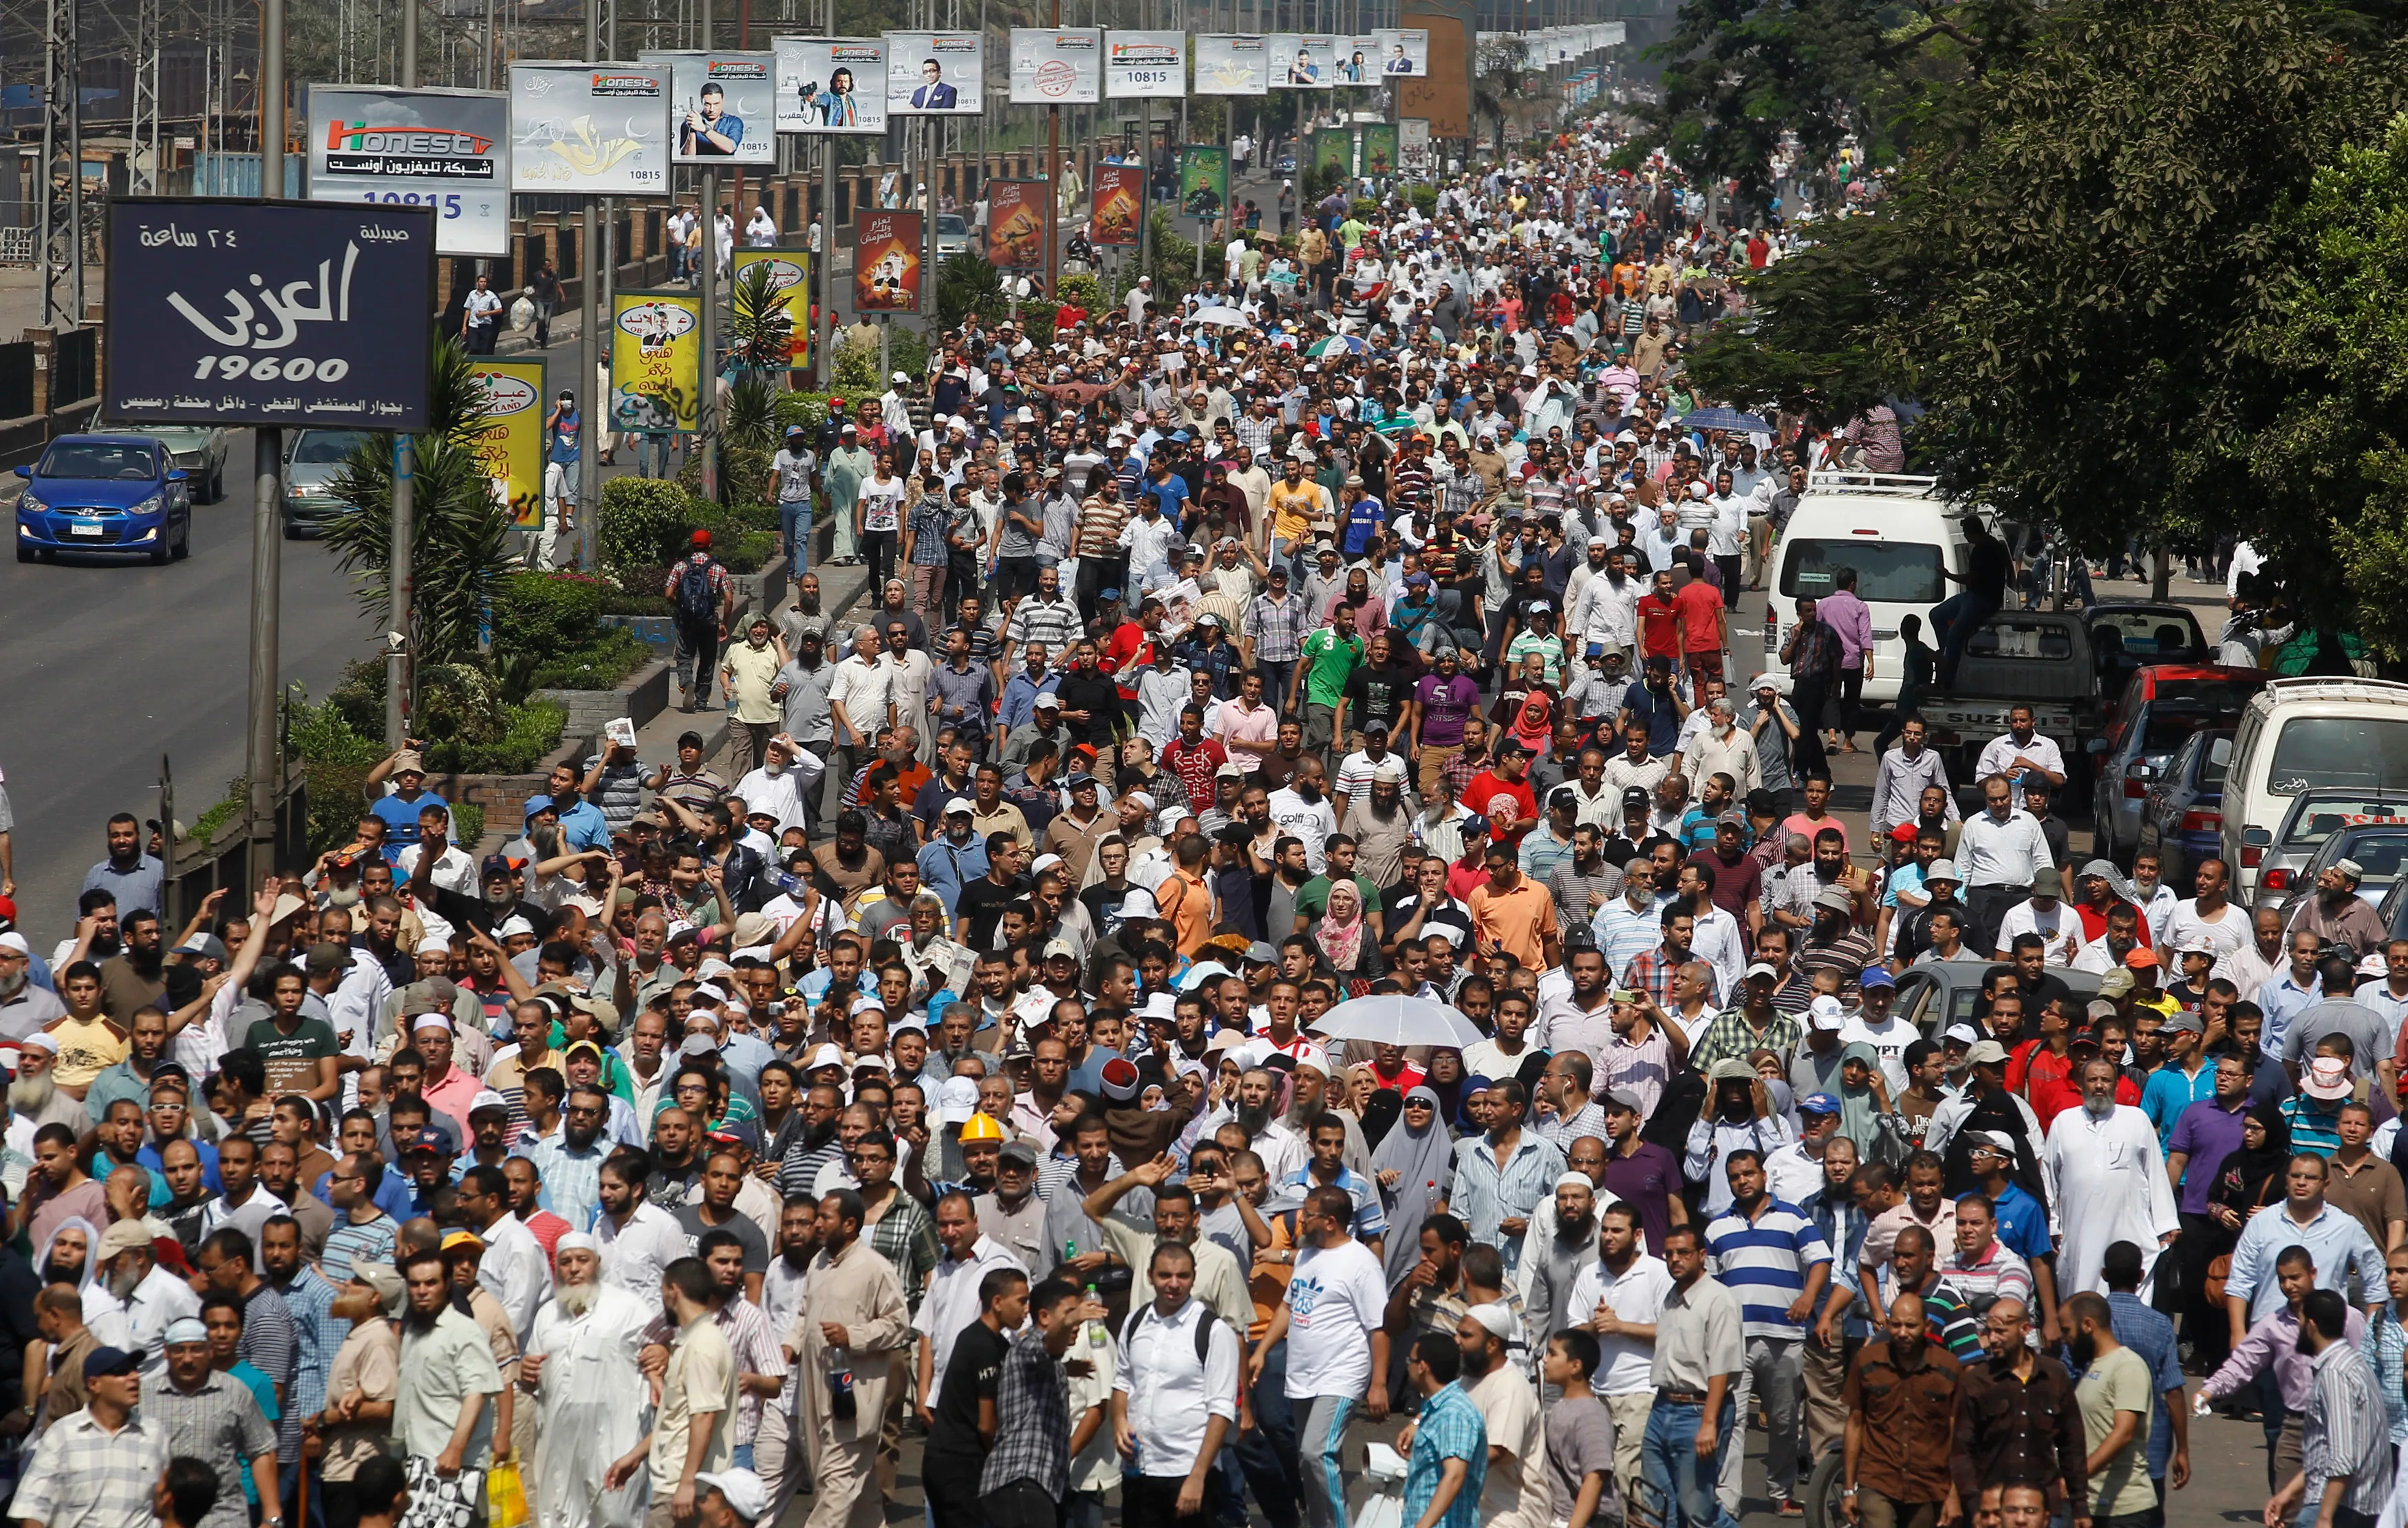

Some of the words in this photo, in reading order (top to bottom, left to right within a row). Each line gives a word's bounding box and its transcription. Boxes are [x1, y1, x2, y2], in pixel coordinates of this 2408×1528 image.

[1128, 72, 1167, 82] 10815
[778, 111, 807, 120] العقرب
[329, 156, 384, 173] أونست
[386, 159, 441, 174] تليفزيون
[443, 160, 491, 176] شبكة
[630, 171, 660, 180] 10815
[140, 222, 197, 248] ساعة
[208, 228, 237, 248] ٢٤
[361, 224, 409, 243] صيدلية
[194, 354, 350, 383] 19600
[120, 397, 170, 410] رمسيس
[173, 394, 211, 409] محطة
[216, 396, 246, 412] داخل
[261, 397, 300, 413] القبطى
[304, 399, 365, 413] المستشفى
[369, 401, 402, 416] بجوار
[495, 401, 522, 413] LAND
[1323, 636, 1334, 651] 3
[2273, 777, 2309, 792] الطيب
[1280, 813, 1305, 826] golff
[268, 1048, 303, 1057] something
